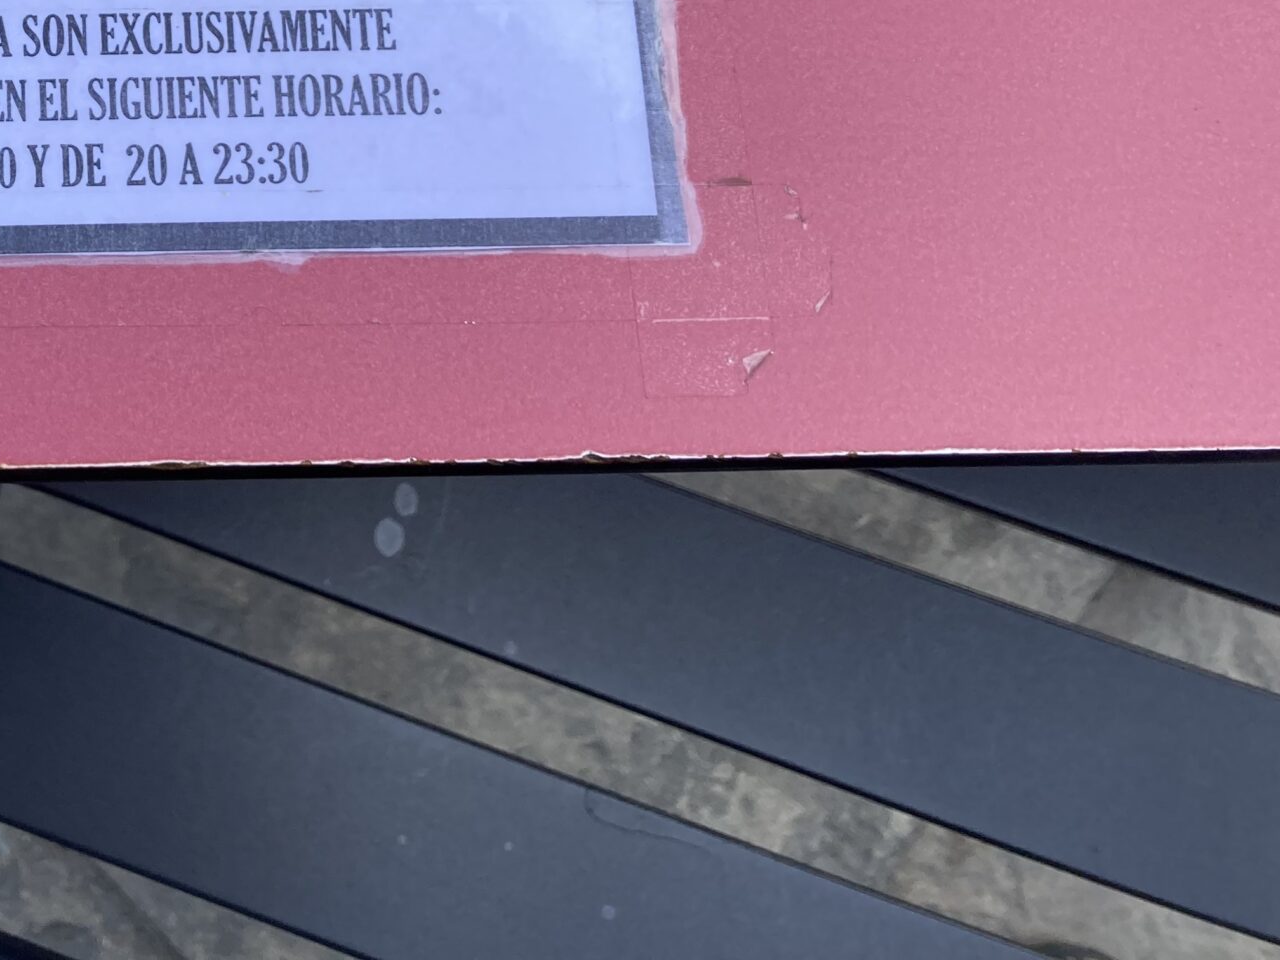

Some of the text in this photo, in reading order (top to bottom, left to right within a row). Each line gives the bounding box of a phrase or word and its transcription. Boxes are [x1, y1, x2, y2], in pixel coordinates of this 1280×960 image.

[21, 13, 89, 58] SON
[98, 8, 397, 56] EXCLUSIVAMENTE
[37, 78, 79, 122] EL
[87, 74, 265, 121] SIGUIENTE
[271, 72, 442, 118] HORARIO:
[26, 143, 51, 188] Y
[60, 143, 107, 188] DE
[125, 143, 168, 187] 20
[178, 142, 204, 186] A
[212, 141, 310, 185] 23:30
